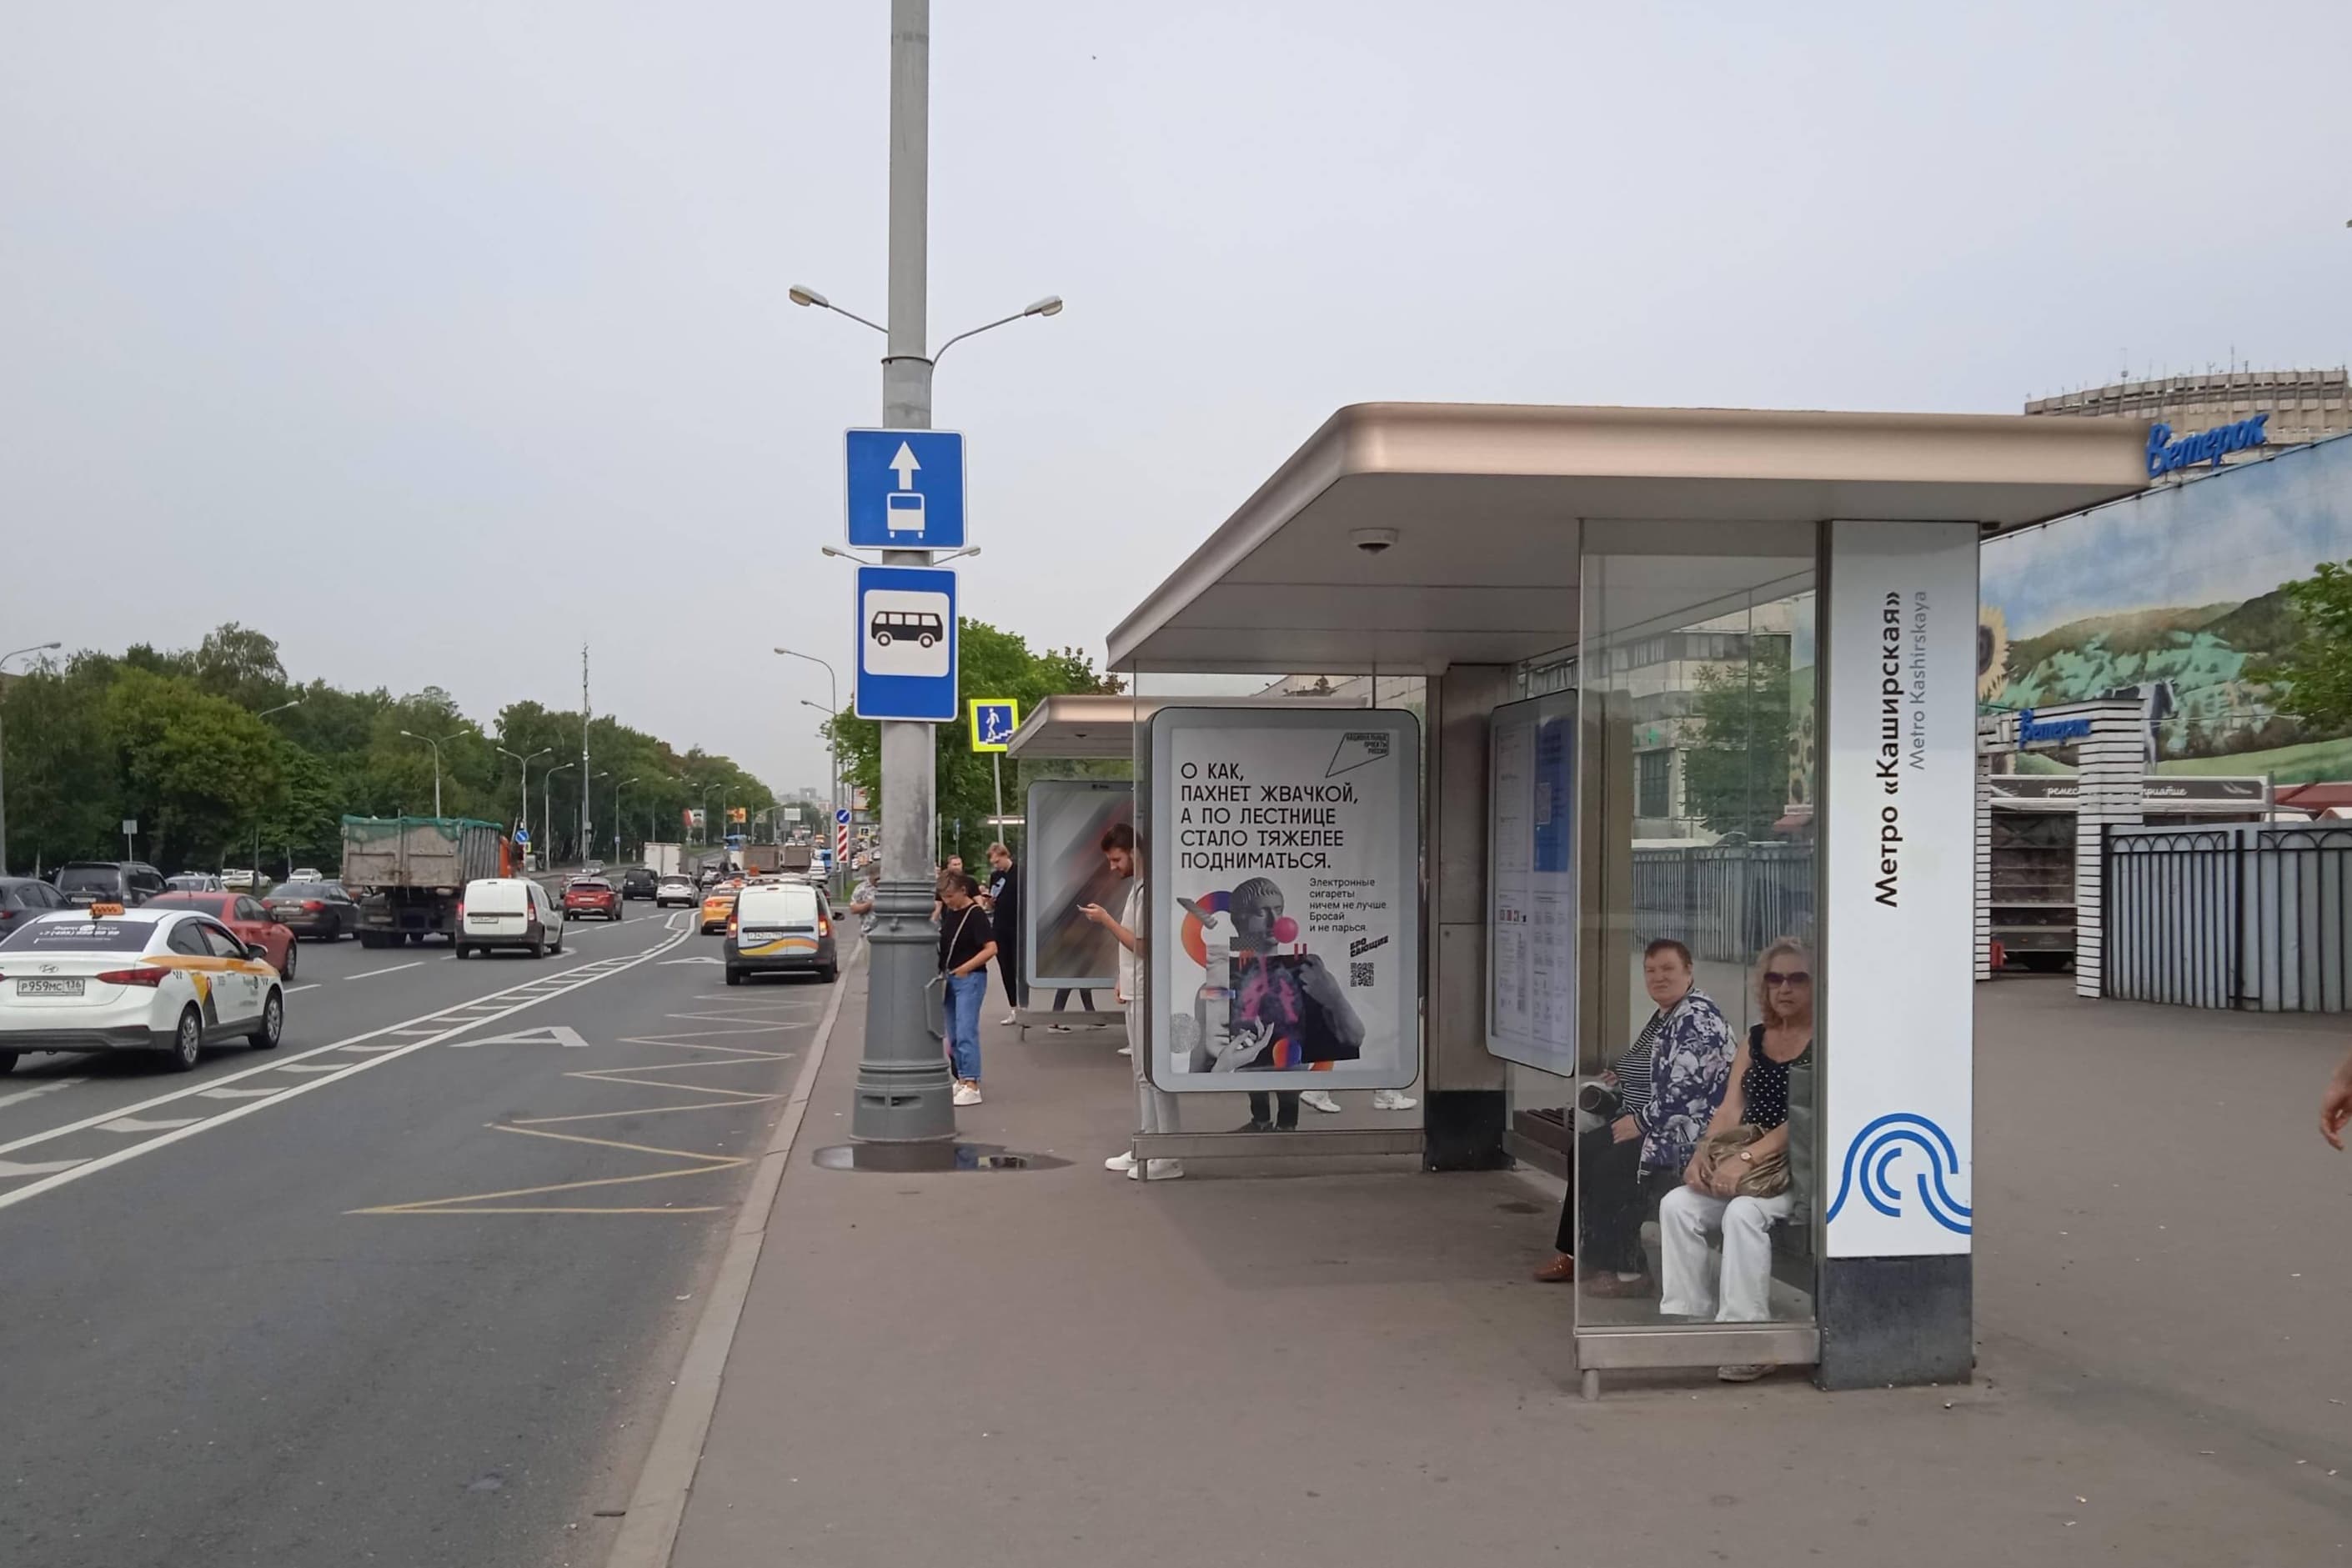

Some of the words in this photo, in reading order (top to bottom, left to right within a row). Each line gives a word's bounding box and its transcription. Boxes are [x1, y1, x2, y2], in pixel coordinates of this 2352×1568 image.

[2146, 413, 2269, 479] Ветерок
[1909, 591, 1930, 704] Kashirskaya
[1876, 591, 1904, 795] «Каширская»
[1909, 710, 1926, 770] Metro
[1181, 762, 1197, 779] О
[1208, 763, 1244, 782] КАК,
[1181, 785, 1251, 802] ПАХНЕТ
[1261, 782, 1359, 804] ЖВАЧКОЙ,
[1181, 808, 1192, 824] А
[1202, 808, 1231, 824] ПО
[1240, 808, 1336, 827] ЛЕСТНИЦЕ
[1181, 829, 1248, 846] СТАЛО
[1257, 830, 1344, 846] ТЯЖЕЛЕЕ
[1181, 852, 1331, 872] ПОДНИМАТЬСЯ.
[1875, 806, 1903, 908] Метро
[1309, 877, 1376, 888] Электронные
[1309, 890, 1355, 899] сигареты
[1309, 911, 1345, 922] Бросай
